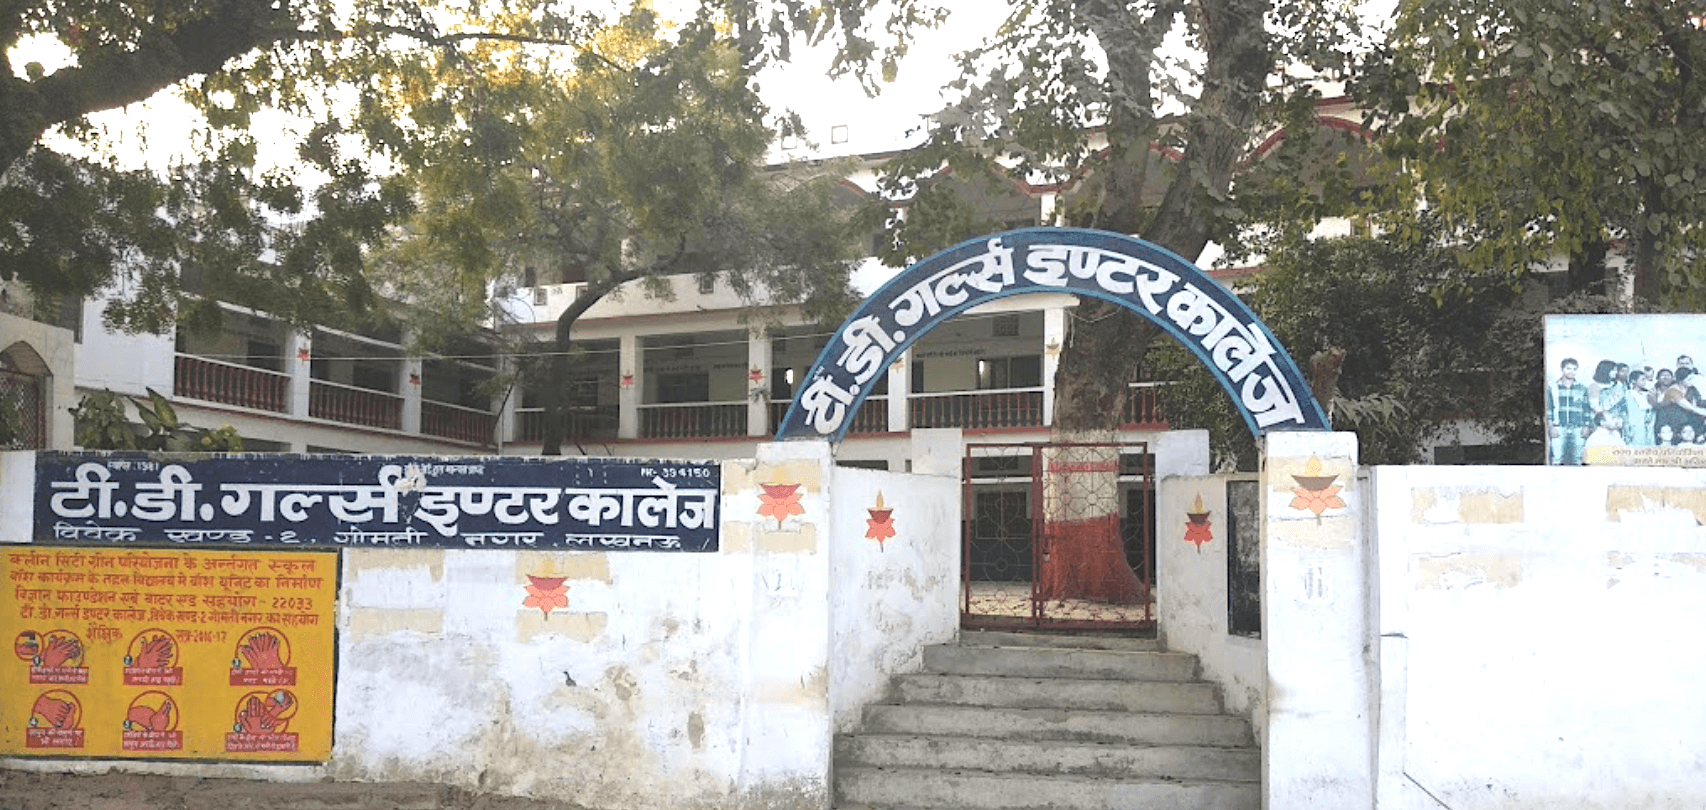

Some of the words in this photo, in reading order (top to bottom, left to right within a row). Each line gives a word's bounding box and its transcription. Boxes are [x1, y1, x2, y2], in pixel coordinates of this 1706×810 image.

[1023, 245, 1181, 315] इण्टर
[414, 486, 562, 537] इण्टर
[53, 520, 142, 542] विवेक
[334, 525, 428, 545] गोमती
[55, 552, 86, 568] सिटी
[182, 552, 197, 570] के
[254, 577, 271, 589] का
[272, 597, 313, 610] 22033
